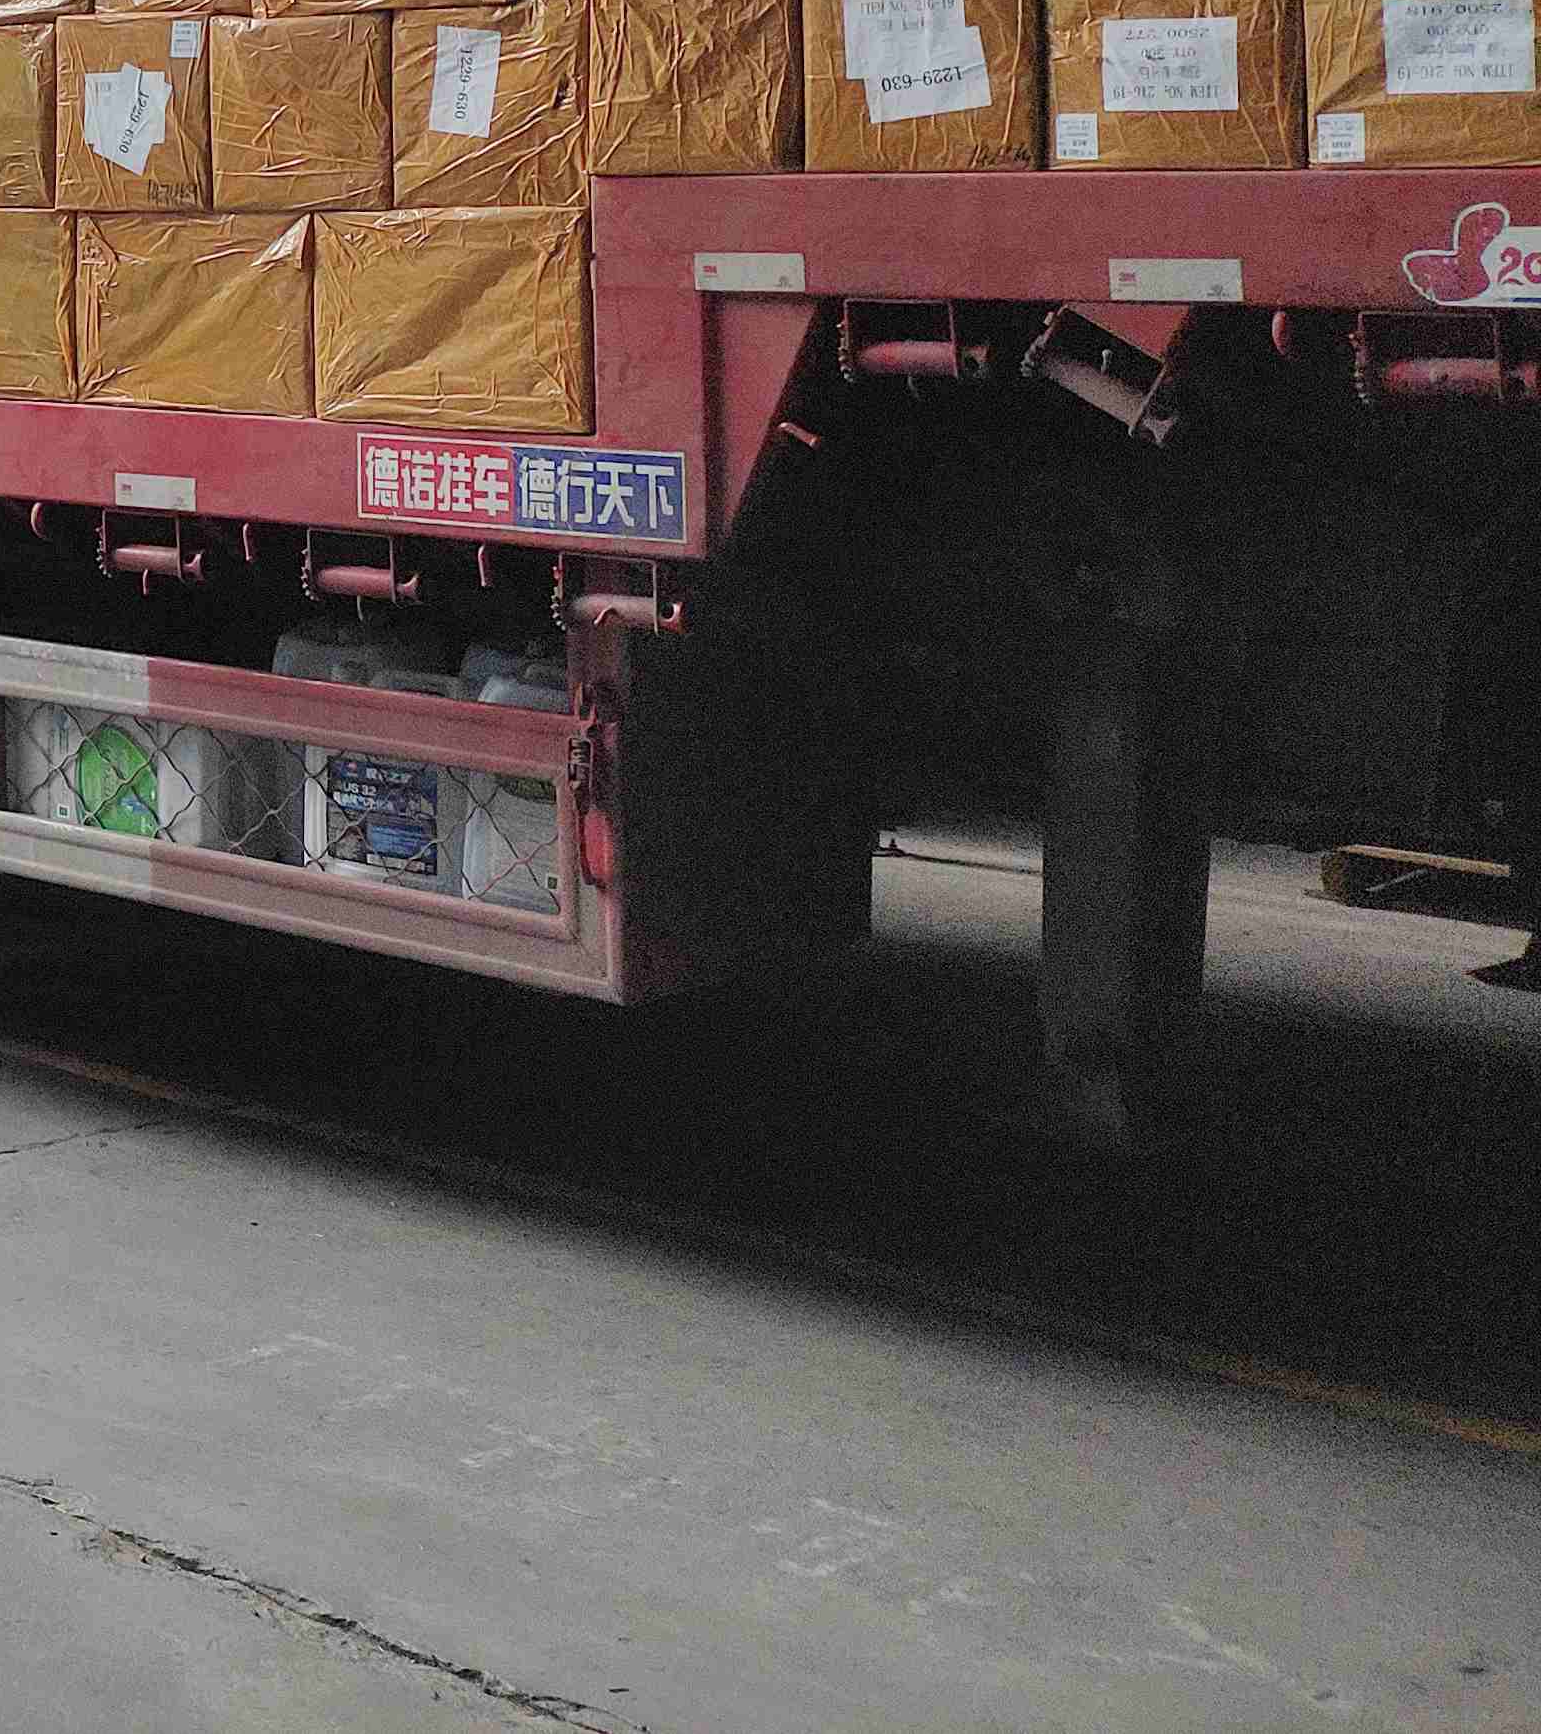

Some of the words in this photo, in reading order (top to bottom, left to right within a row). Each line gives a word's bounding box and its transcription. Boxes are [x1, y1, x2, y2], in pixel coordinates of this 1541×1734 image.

[454, 48, 474, 120] 1229-630
[881, 66, 963, 93] 1229-630
[1482, 63, 1514, 79] ITEM
[1190, 85, 1221, 99] ITEM
[365, 444, 510, 517] 德诺挂车
[518, 455, 676, 530] 德行天下
